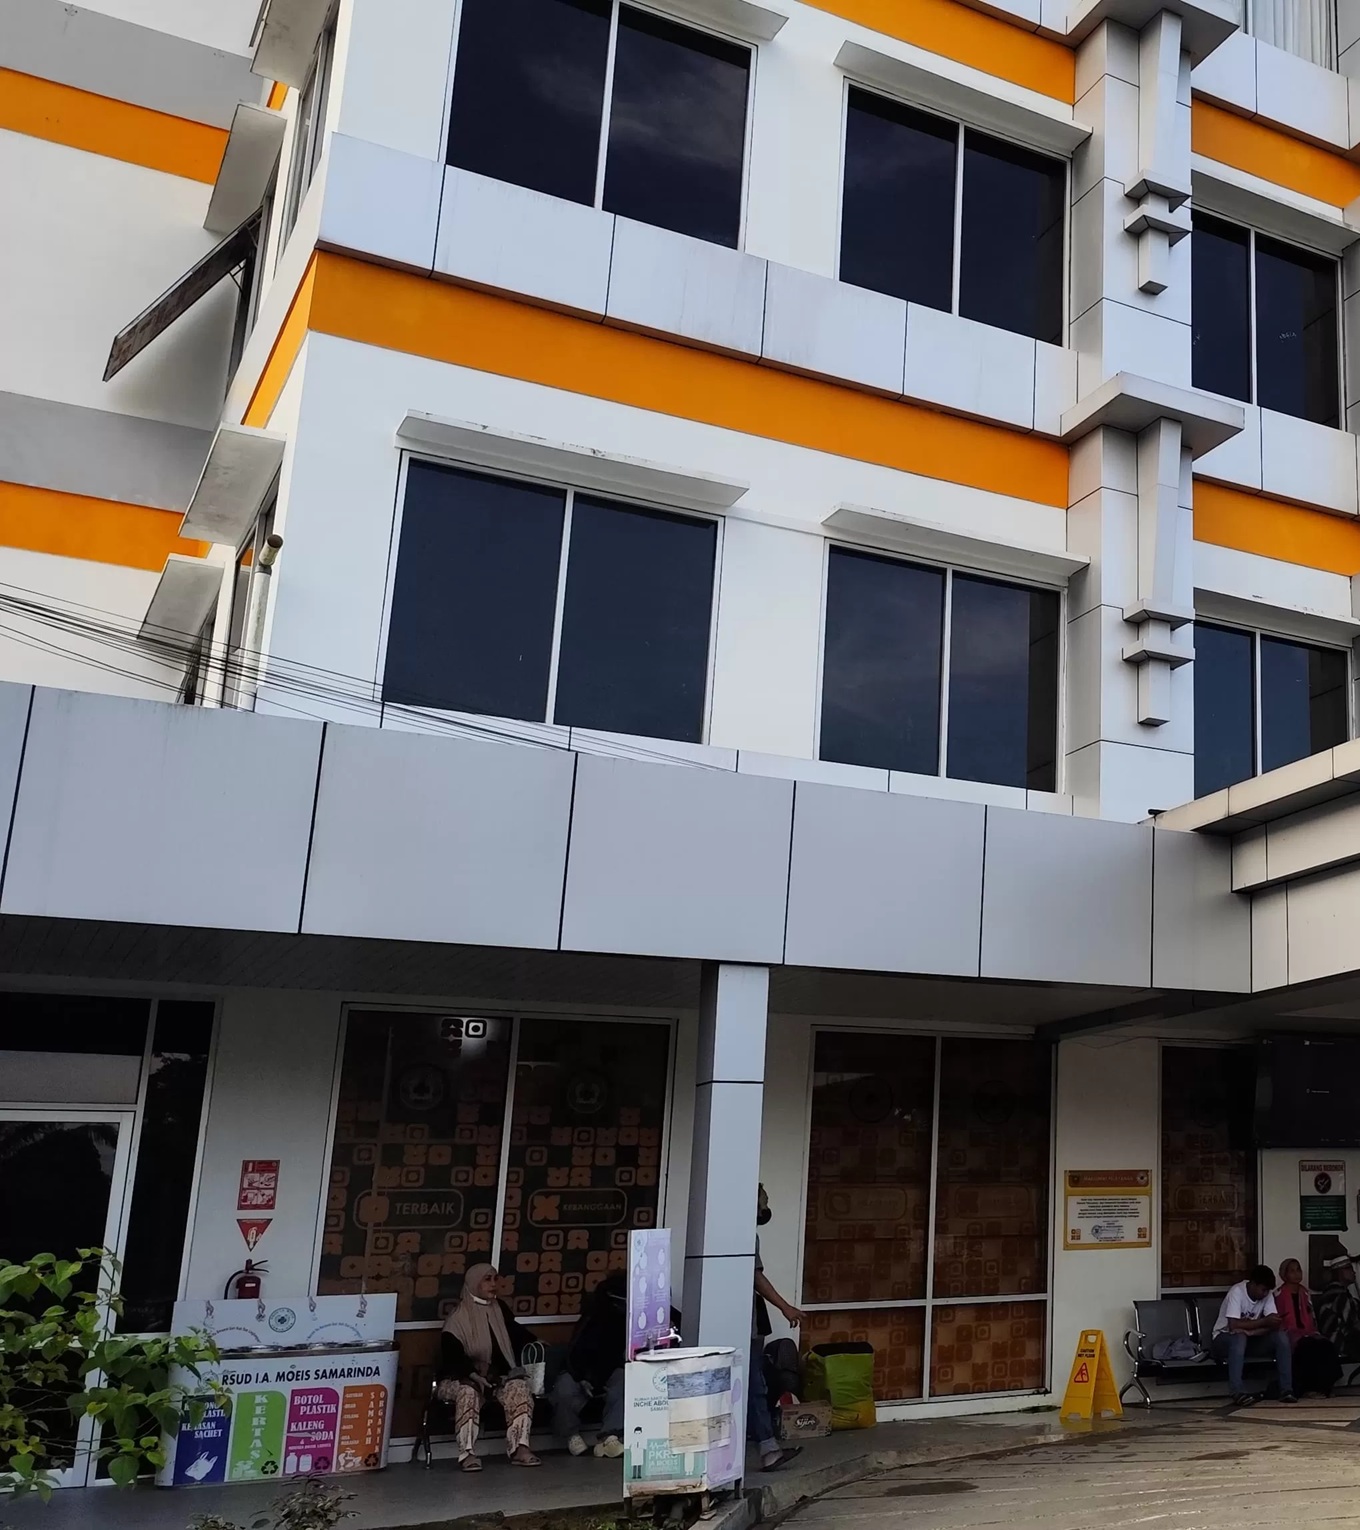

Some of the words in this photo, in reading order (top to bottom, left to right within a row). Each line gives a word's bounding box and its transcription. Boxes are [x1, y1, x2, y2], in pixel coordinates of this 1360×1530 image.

[395, 1201, 455, 1215] TERBAIK
[563, 1203, 622, 1211] KEBANGGAAN
[221, 1373, 252, 1386] RSUD
[255, 1373, 272, 1384] I.A.
[275, 1369, 311, 1383] MOEIS
[313, 1365, 381, 1380] SAMARINDA
[293, 1394, 324, 1405] BOTOL
[300, 1404, 337, 1415] PLASTIK
[365, 1391, 375, 1445] SAMPAH
[374, 1391, 385, 1453] ORGANIK
[181, 1421, 217, 1431] KEASAN
[250, 1394, 269, 1460] KERTAS
[290, 1420, 325, 1432] KALENG
[194, 1429, 223, 1439] SACHET
[311, 1430, 334, 1442] SODA
